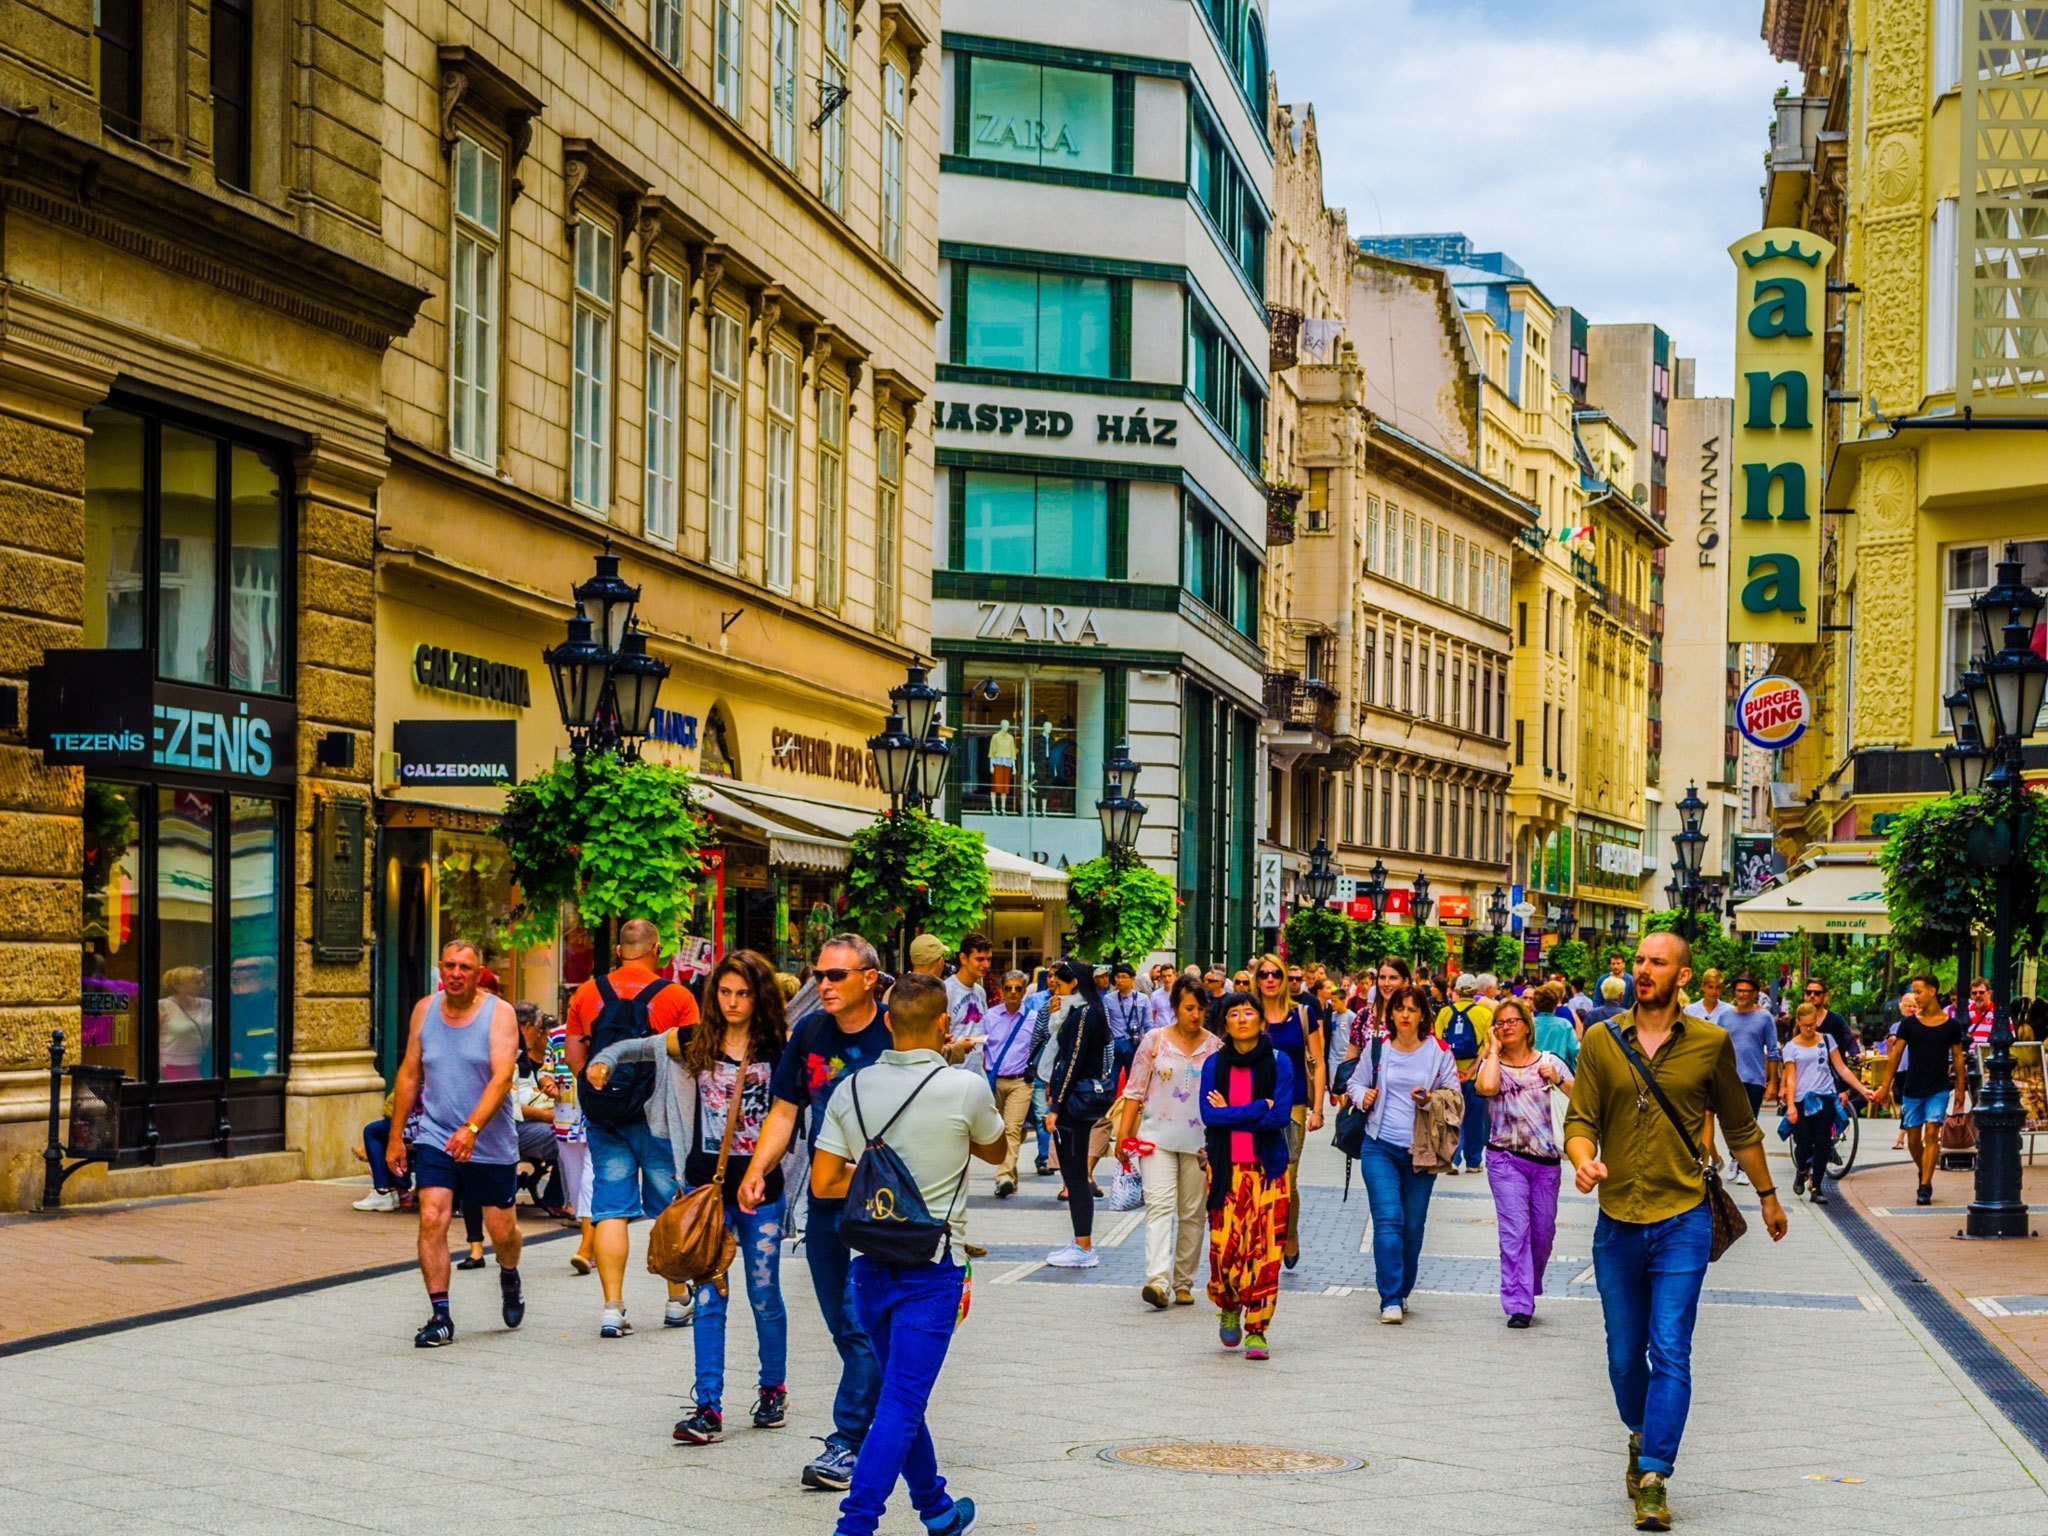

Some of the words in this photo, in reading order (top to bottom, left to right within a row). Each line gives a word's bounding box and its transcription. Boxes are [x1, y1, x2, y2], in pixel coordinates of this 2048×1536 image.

[976, 113, 1080, 155] ZARA
[1097, 407, 1177, 447] HÁZ
[1741, 276, 1813, 614] anna
[1697, 436, 1719, 568] FONTANA
[976, 601, 1108, 646] ZARA
[414, 643, 531, 708] CALZEDONIA
[1745, 689, 1800, 716] BURGER
[1748, 702, 1802, 735] KING
[50, 730, 145, 751] TEZENIS
[153, 702, 272, 777] EZENIS
[772, 727, 832, 777] SOUVENIR
[834, 743, 863, 786] AERO
[403, 764, 509, 777] CALZEDONIA
[1263, 860, 1276, 922] ZARA
[1849, 919, 1867, 927] café
